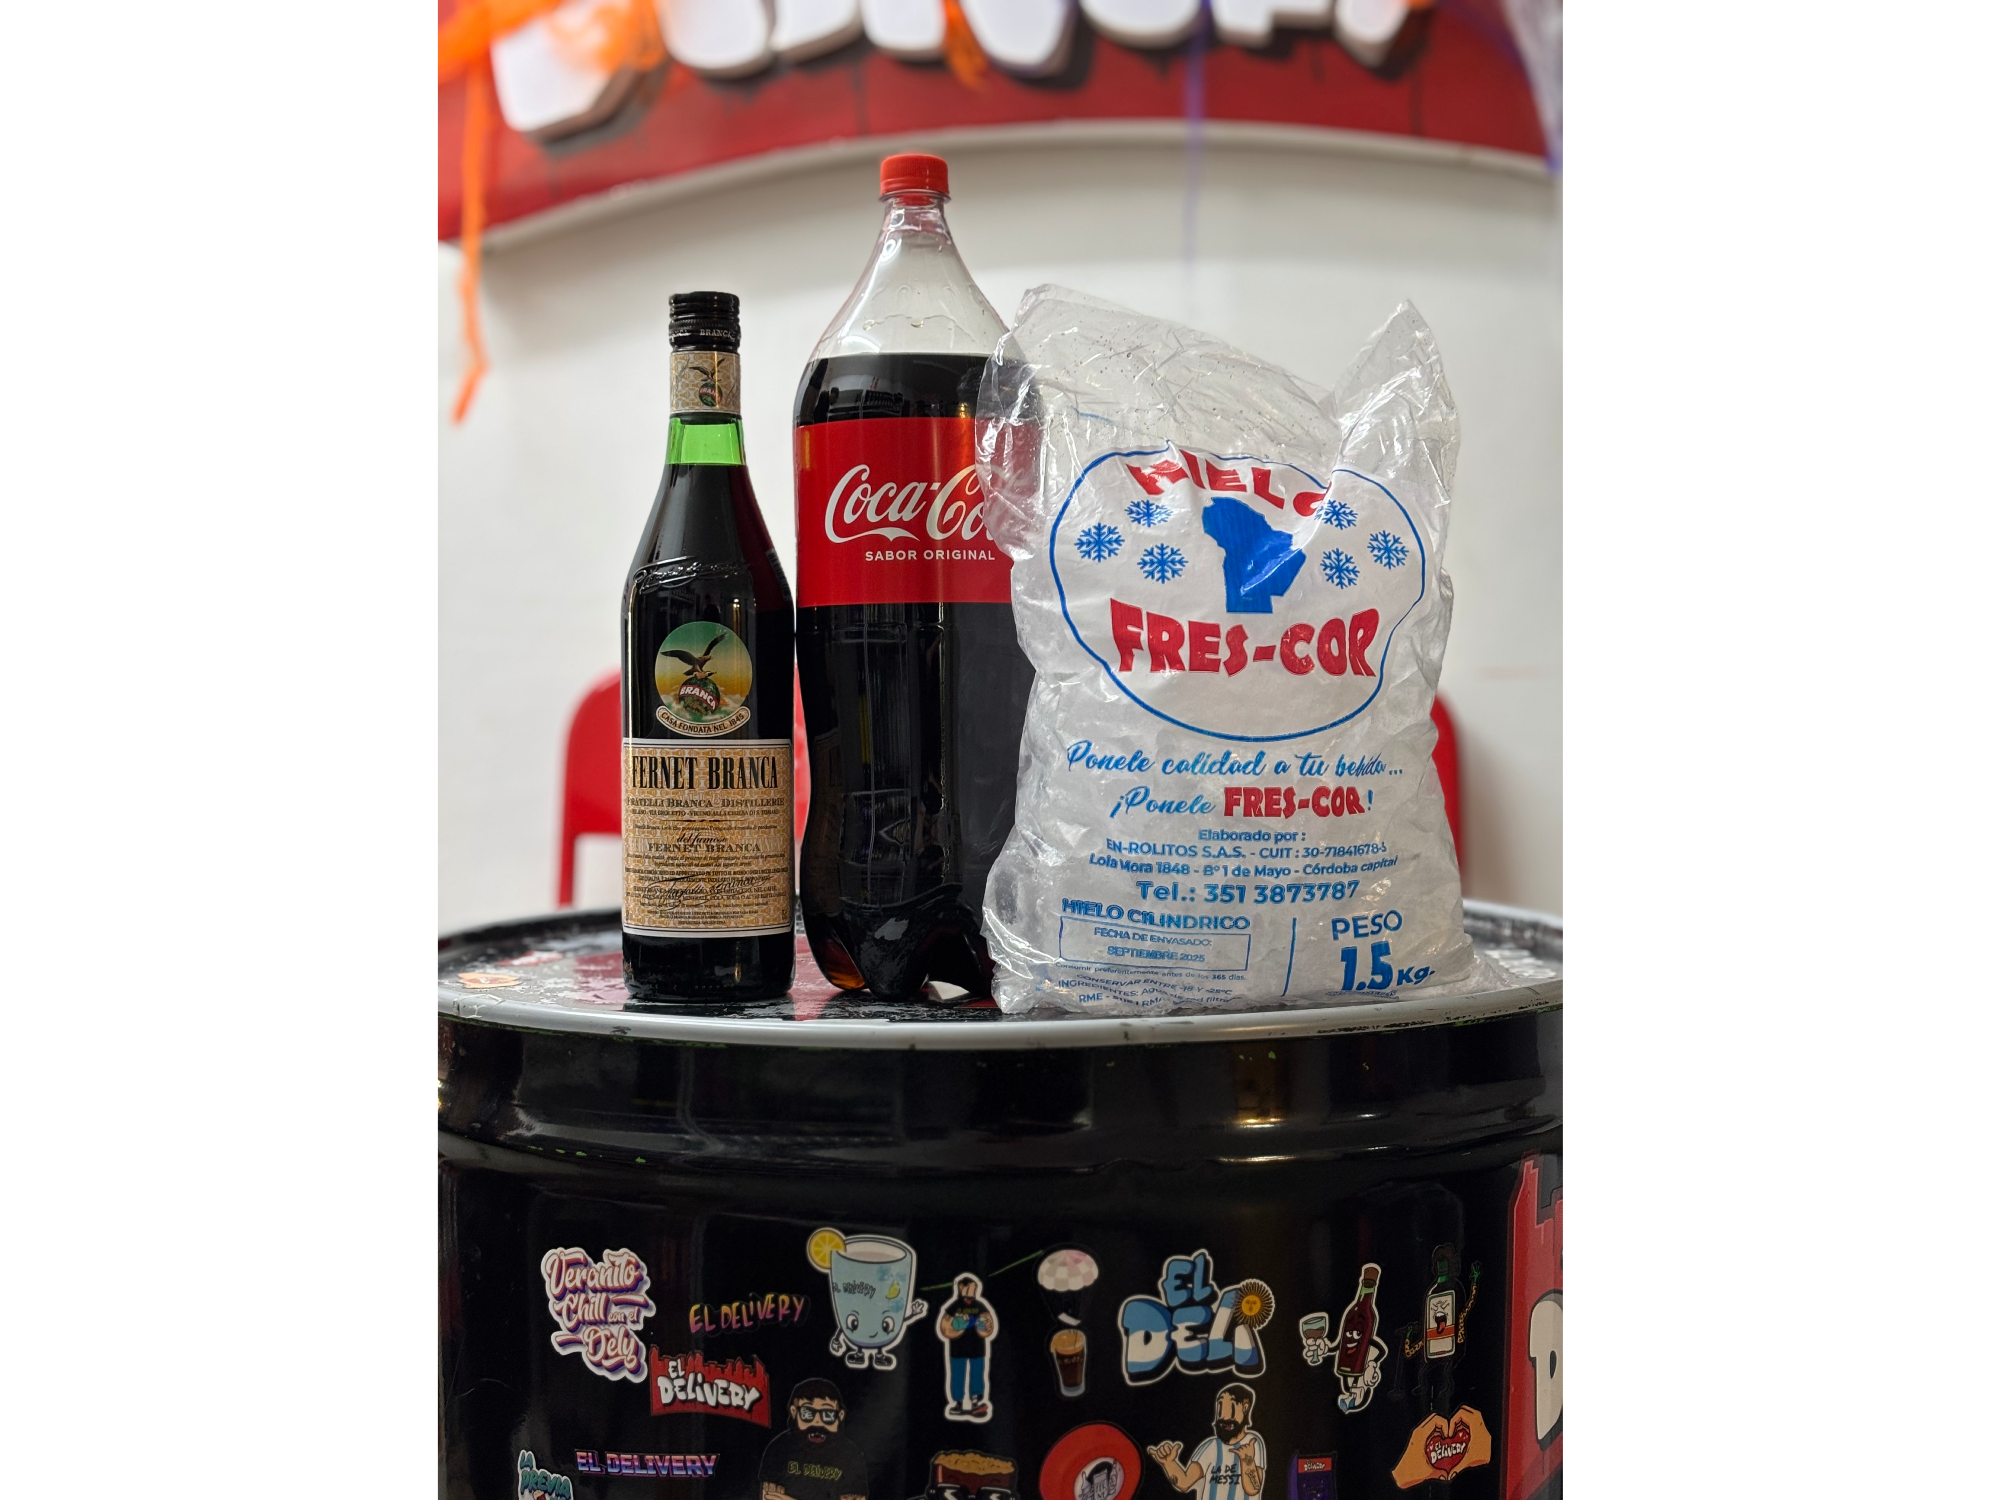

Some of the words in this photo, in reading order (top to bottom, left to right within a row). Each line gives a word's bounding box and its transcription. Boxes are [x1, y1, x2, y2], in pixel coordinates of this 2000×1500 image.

[865, 550, 918, 562] SABOR
[923, 549, 996, 561] ORIGINAL
[1110, 598, 1380, 678] FRES-COR
[680, 686, 716, 711] BRANCA
[661, 711, 677, 728] CASA
[679, 722, 712, 733] FONDATA
[713, 722, 728, 732] NEL
[729, 713, 745, 727] 1845
[1067, 740, 1155, 772] Ponele
[1161, 749, 1268, 776] calidad
[1274, 759, 1291, 775] a
[1294, 752, 1329, 776] tu
[632, 755, 698, 790] FERNET
[708, 755, 779, 790] BRANCA
[667, 797, 714, 808] BRANCA
[721, 797, 785, 808] DISTILLERIE
[1109, 785, 1216, 819] ¡Ponele
[648, 842, 703, 852] FERNET
[706, 842, 761, 853] BRANCA
[1106, 838, 1198, 858] EN-ROLITOS
[1259, 847, 1293, 859] CUIT
[1198, 828, 1271, 841] Elaborado
[1274, 831, 1299, 844] por
[1089, 853, 1118, 869] Lola
[1156, 861, 1190, 875] 1848
[1231, 864, 1250, 877] de
[1254, 865, 1291, 879] Mayo
[1302, 862, 1358, 875] Córdoba
[1136, 880, 1196, 902] Tel.:
[1204, 883, 1246, 905] 351
[1254, 879, 1360, 905] 3873787
[1094, 926, 1130, 940] FECHA
[1132, 932, 1148, 942] DE
[1150, 934, 1212, 947] ENVASADO:
[1331, 909, 1403, 941] PESO
[1107, 945, 1178, 961] SEPTIEMBRE
[1180, 952, 1205, 963] 2025
[1341, 941, 1394, 991] 1.5
[1058, 979, 1139, 996] INGREDIENTES:
[1077, 975, 1142, 987] CONSERVAR
[1143, 978, 1177, 990] ENTRE
[545, 1250, 643, 1298] Veranito
[1163, 1253, 1213, 1307] EL
[553, 1291, 609, 1331] Chill
[608, 1310, 626, 1324] con
[628, 1307, 640, 1322] el
[689, 1304, 716, 1333] EL
[584, 1325, 641, 1374] Dely
[668, 1358, 685, 1379] EL
[1435, 1441, 1441, 1450] EL
[520, 1451, 533, 1469] LA
[576, 1451, 603, 1473] EL
[606, 1453, 717, 1476] DELIVERY
[1211, 1465, 1222, 1474] LA
[1225, 1463, 1237, 1473] DE
[520, 1469, 571, 1499] PREVIA
[1210, 1473, 1241, 1485] MESSI
